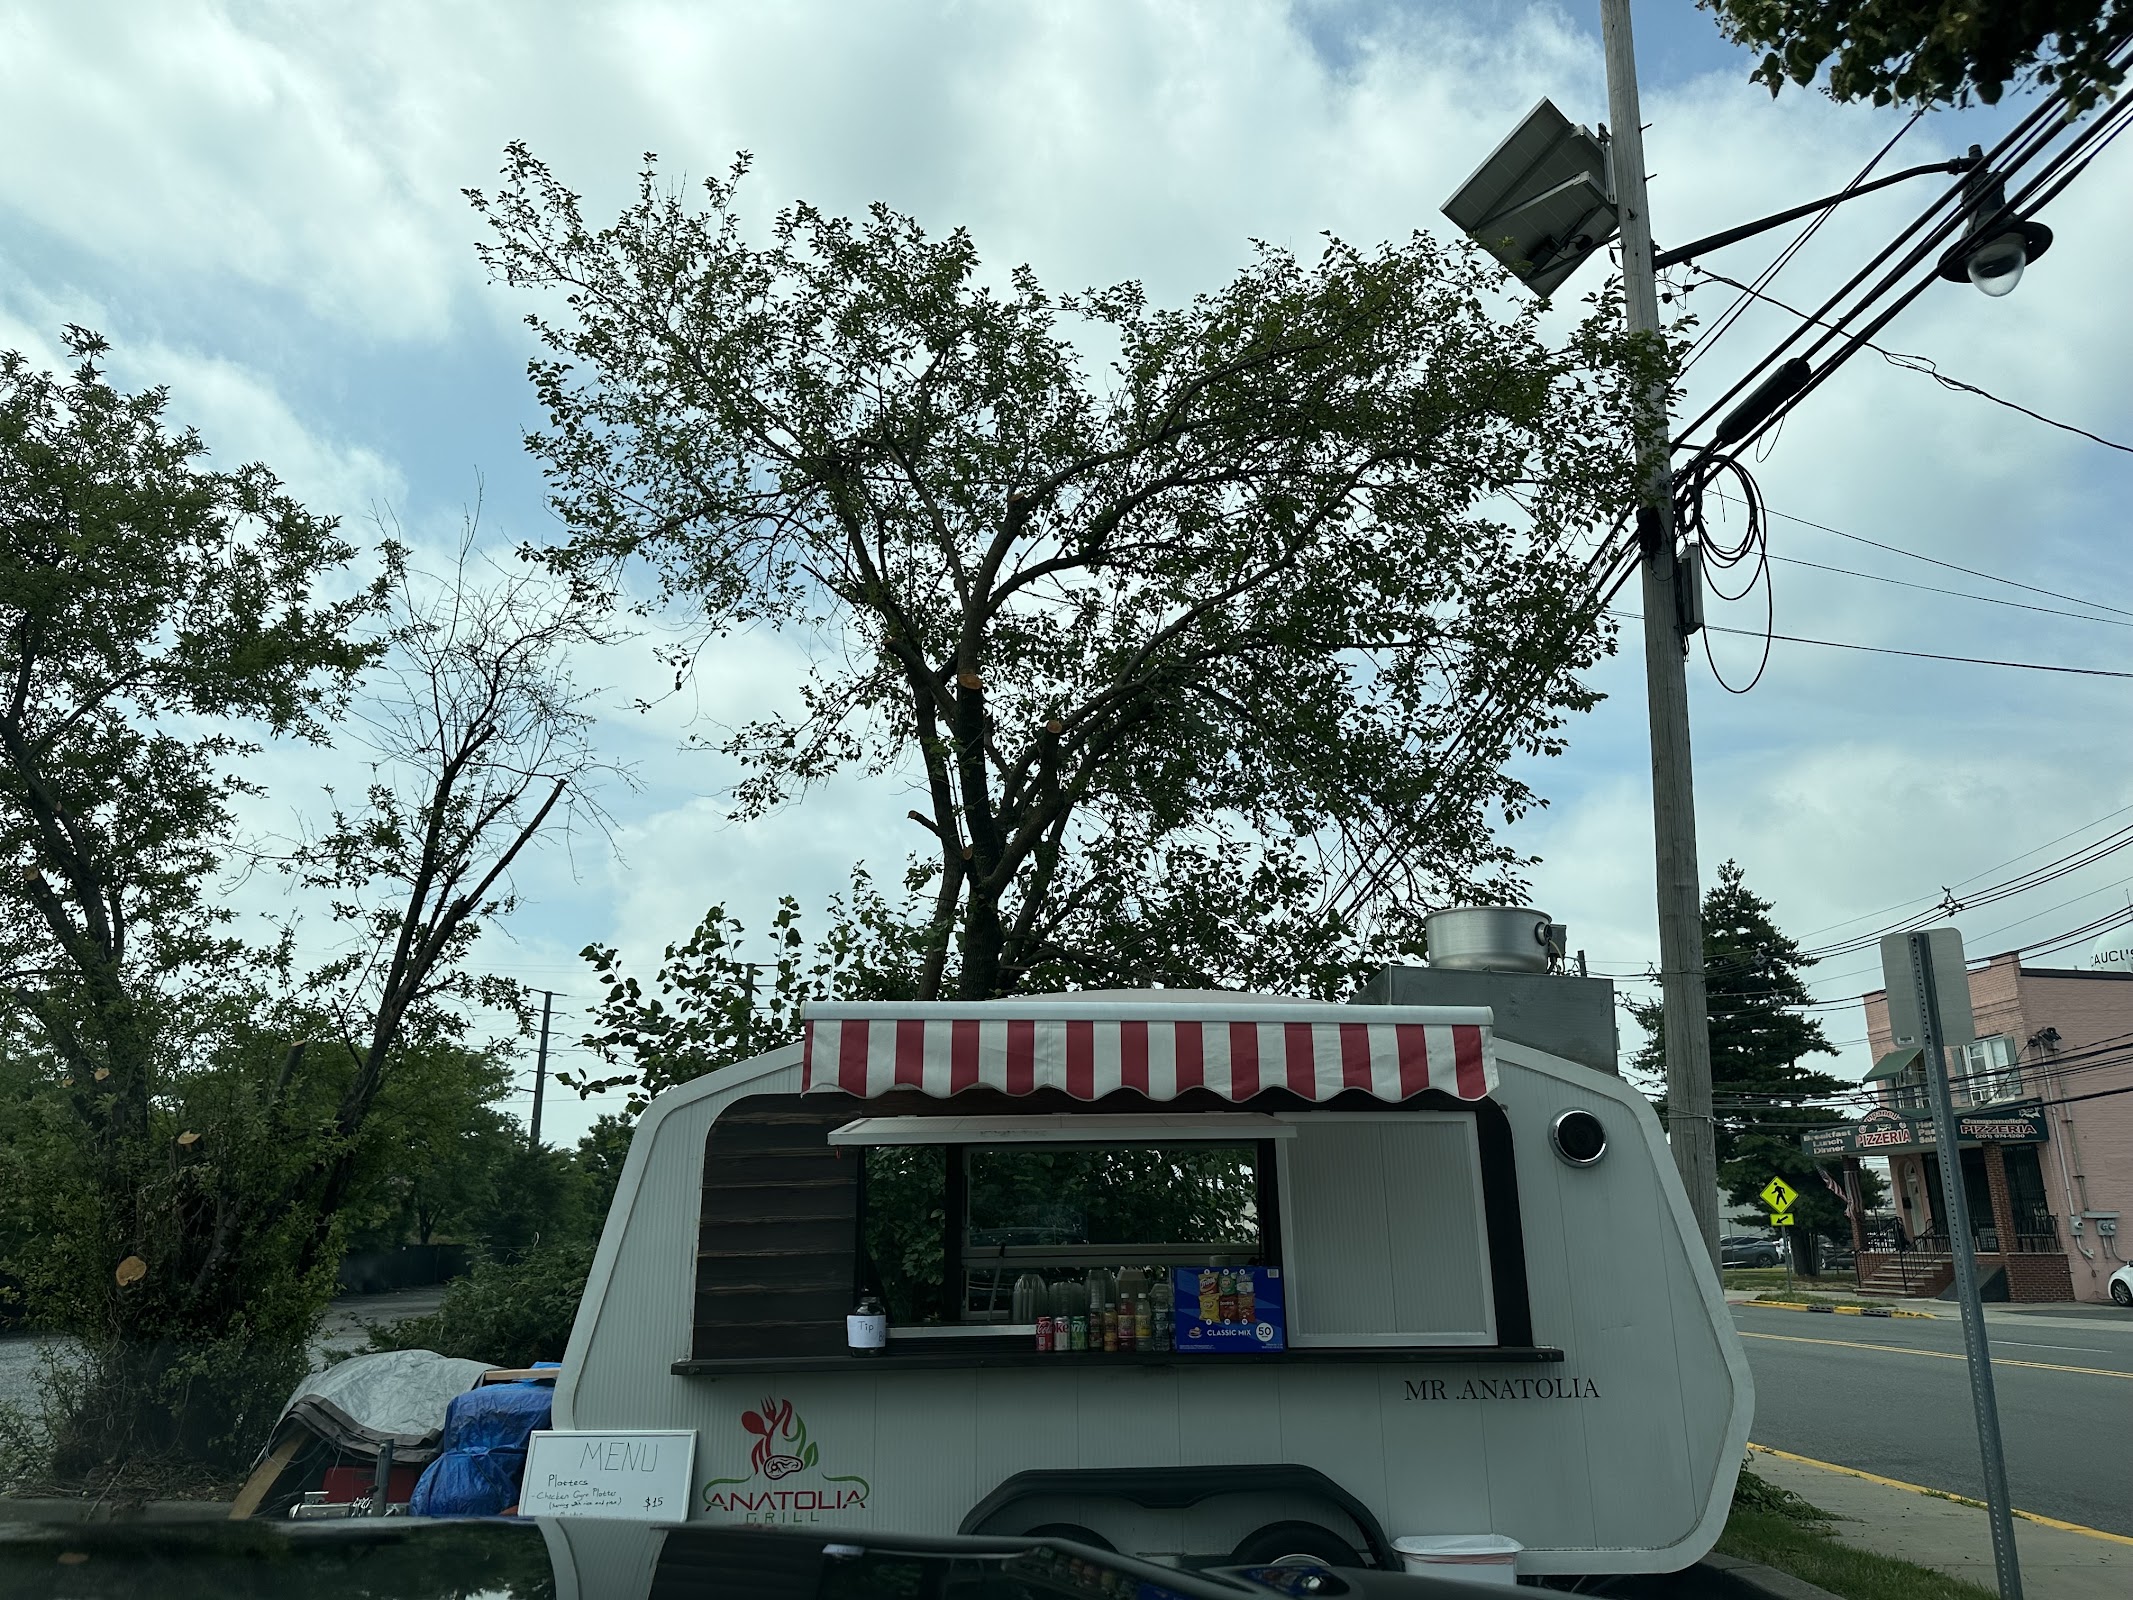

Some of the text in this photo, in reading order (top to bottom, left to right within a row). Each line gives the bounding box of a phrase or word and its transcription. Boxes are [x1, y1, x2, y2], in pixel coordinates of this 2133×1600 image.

[1960, 1124, 2037, 1134] PIZZERIA
[1803, 1130, 1852, 1141] Breakfast
[1855, 1129, 1912, 1148] PIZZERIA
[1813, 1138, 1843, 1147] Lunch
[1813, 1146, 1845, 1154] Dinner
[858, 1321, 874, 1333] Tip
[1258, 1327, 1271, 1336] 50
[1404, 1380, 1448, 1400] MR
[580, 1442, 658, 1472] MENU
[643, 1497, 664, 1511] $15
[705, 1490, 866, 1511] ANATOLIA
[747, 1512, 820, 1523] GRILL
